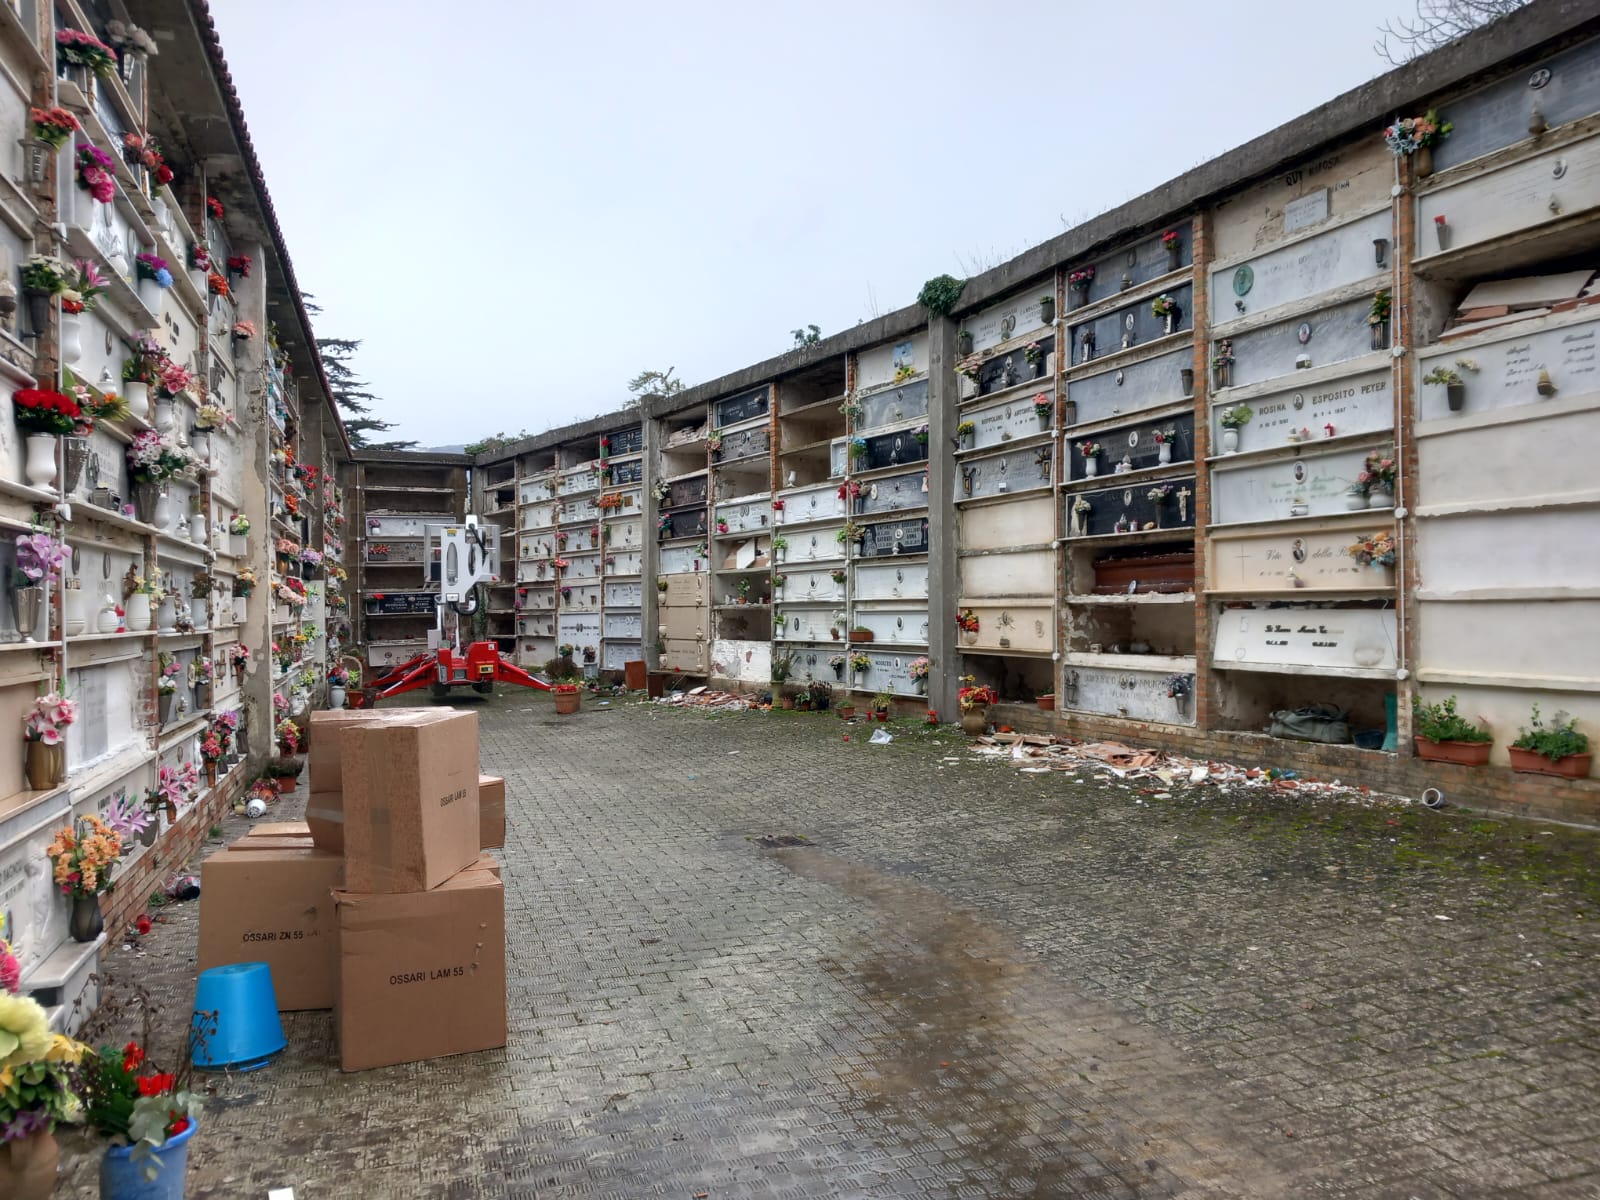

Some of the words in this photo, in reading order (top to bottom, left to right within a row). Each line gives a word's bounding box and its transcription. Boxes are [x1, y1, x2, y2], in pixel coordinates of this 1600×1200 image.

[1260, 404, 1287, 416] ROSINA
[1312, 388, 1355, 405] ESPOSITO
[243, 932, 276, 942] OSSARI
[279, 931, 291, 940] ZN
[293, 931, 304, 940] 55
[389, 972, 426, 985] OSSARI
[430, 968, 451, 980] LAM
[453, 966, 464, 977] 55
